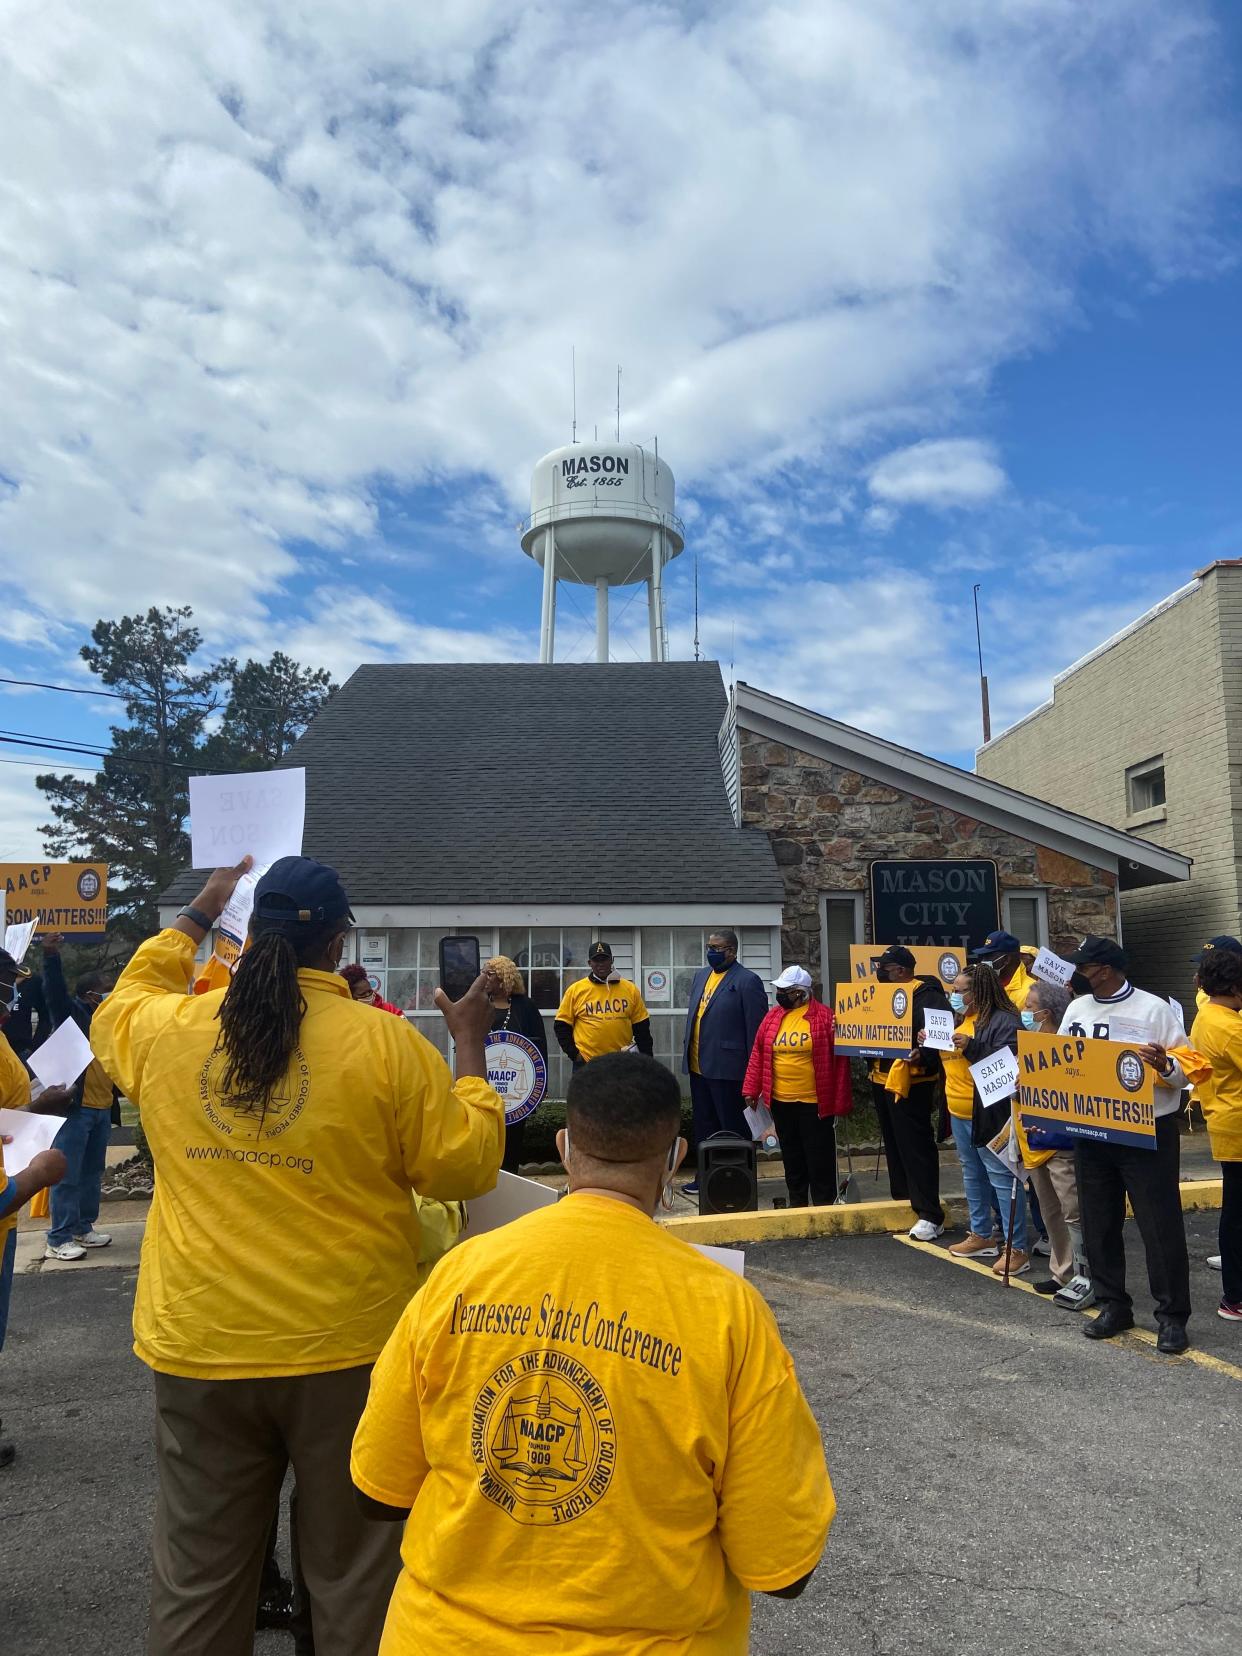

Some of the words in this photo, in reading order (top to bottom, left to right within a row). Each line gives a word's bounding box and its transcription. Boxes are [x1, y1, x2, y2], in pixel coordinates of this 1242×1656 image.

[562, 455, 629, 477] MASON
[566, 475, 588, 489] Est.
[592, 477, 624, 488] 1855
[6, 865, 51, 895] AACP
[881, 869, 988, 893] MASON
[6, 908, 32, 925] SON
[899, 902, 972, 926] CITY
[596, 943, 605, 952] A
[518, 951, 562, 967] OPEN
[1043, 956, 1067, 975] SAVE
[1037, 963, 1065, 985] MASON
[585, 999, 629, 1016] NAACP
[838, 984, 876, 1015] NAACP
[930, 1015, 948, 1027] SAVE
[773, 1031, 809, 1047] ACP
[835, 1023, 863, 1040] MASON
[865, 1024, 912, 1042] MATTERS!!!
[928, 1029, 950, 1042] MASON
[1023, 1040, 1085, 1073] NAACP
[300, 1064, 309, 1077] OF
[488, 1070, 517, 1082] NAACP
[980, 1058, 1007, 1079] SAVE
[1065, 1067, 1086, 1079] says...
[982, 1071, 1016, 1096] MASON
[288, 1079, 309, 1118] COLORED
[1020, 1085, 1069, 1113] MASON
[1073, 1093, 1154, 1127] MATTERS!!!
[203, 1101, 233, 1134] NATIONAL
[265, 1120, 290, 1139] PEOPLE
[186, 1147, 314, 1175] www.naacp.org
[534, 1293, 581, 1343] State
[582, 1301, 682, 1376] Conference
[519, 1353, 540, 1371] THE
[493, 1365, 517, 1389] FOR
[542, 1352, 608, 1412] ADVANCEMENT
[471, 1385, 497, 1463] ASSOCIATION
[520, 1418, 566, 1443] NAACP
[598, 1419, 613, 1434] OF
[527, 1450, 551, 1465] 1909
[588, 1441, 614, 1495] COLORED
[479, 1469, 517, 1513] NATIONAL
[552, 1490, 593, 1522] PEOPLE
